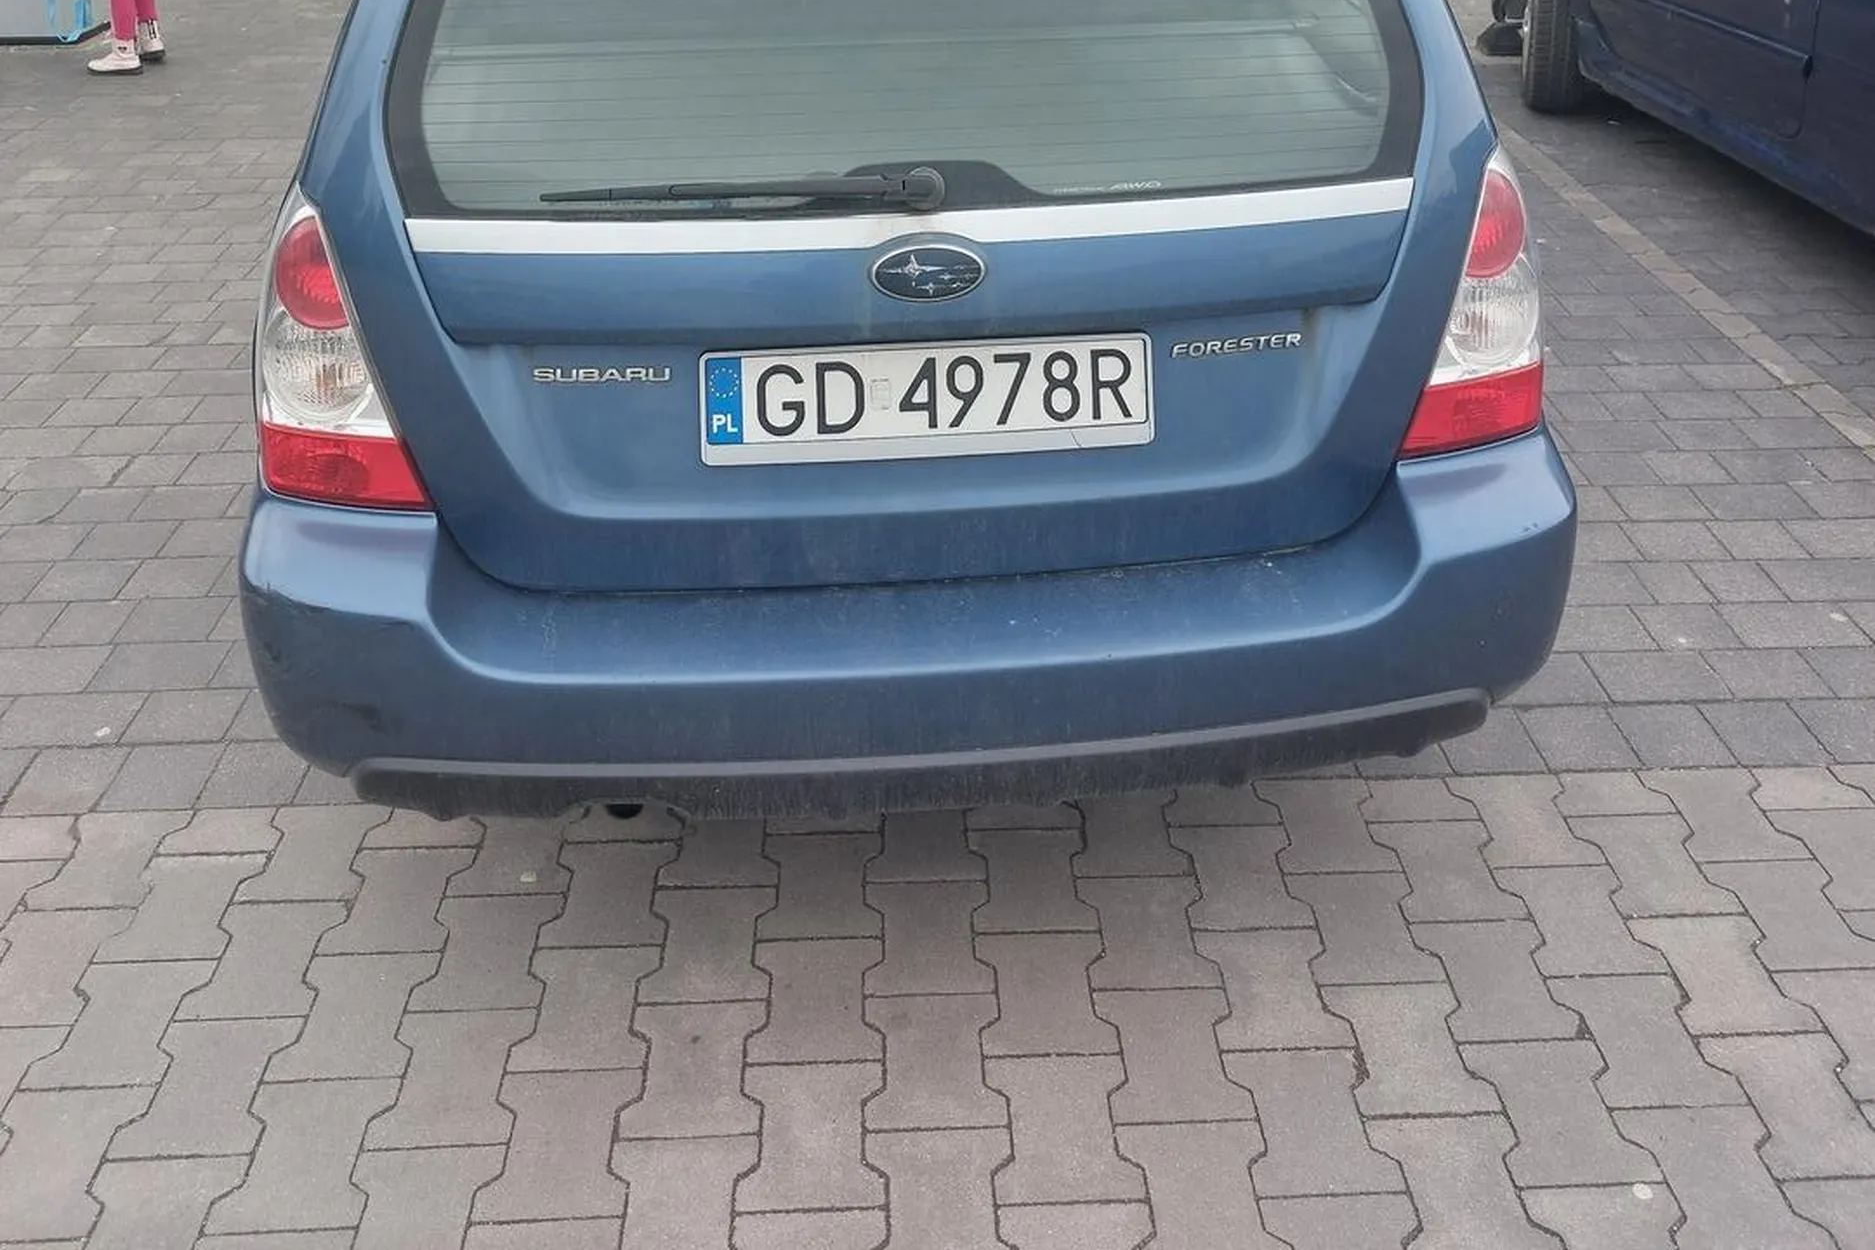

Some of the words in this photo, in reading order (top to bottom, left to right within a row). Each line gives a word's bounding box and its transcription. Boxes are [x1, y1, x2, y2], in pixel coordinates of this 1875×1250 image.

[1171, 332, 1302, 359] FORESTER
[533, 367, 672, 383] SUBARU
[756, 360, 865, 437] GD
[898, 349, 1133, 430] 4978R
[712, 414, 739, 435] PL
